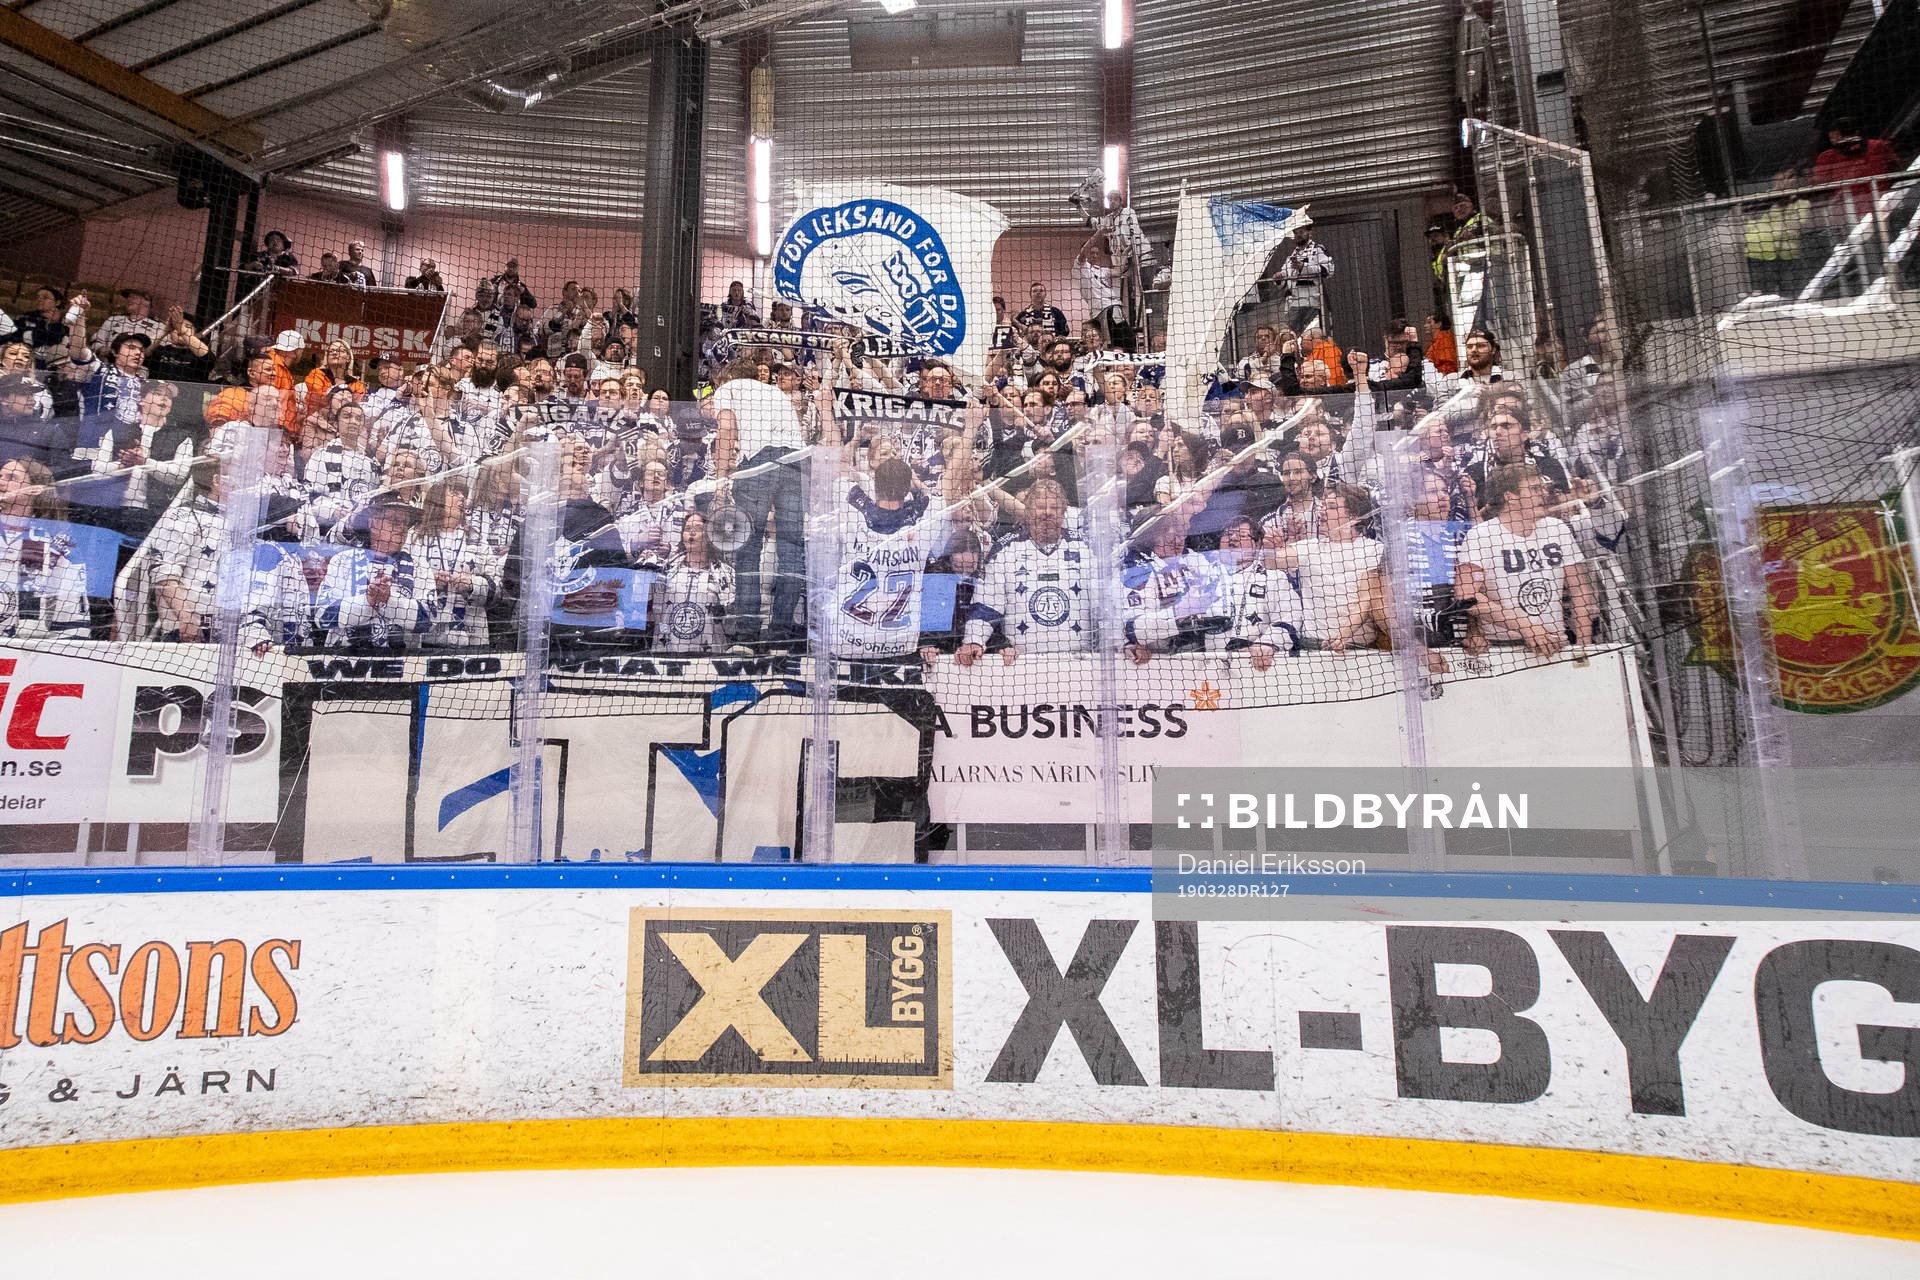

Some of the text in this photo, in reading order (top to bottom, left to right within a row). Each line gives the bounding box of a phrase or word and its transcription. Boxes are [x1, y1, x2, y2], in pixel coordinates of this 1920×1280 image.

[780, 231, 813, 274] FÖR
[812, 204, 917, 241] LEKSAND
[915, 237, 948, 284] FÖR
[295, 318, 432, 352] KIOSK
[727, 331, 803, 346] LEKSAND
[1501, 542, 1563, 574] U&S
[307, 659, 404, 678] WE
[426, 657, 501, 677] DO
[126, 684, 270, 780] ps
[971, 703, 1188, 739] BUSINESS
[1031, 761, 1161, 784] NÄRINSLIV
[891, 934, 924, 1021] BYGG
[646, 932, 925, 1063] XL
[984, 918, 1920, 1138] XL-BYG
[48, 1065, 276, 1103] & JÄRN
